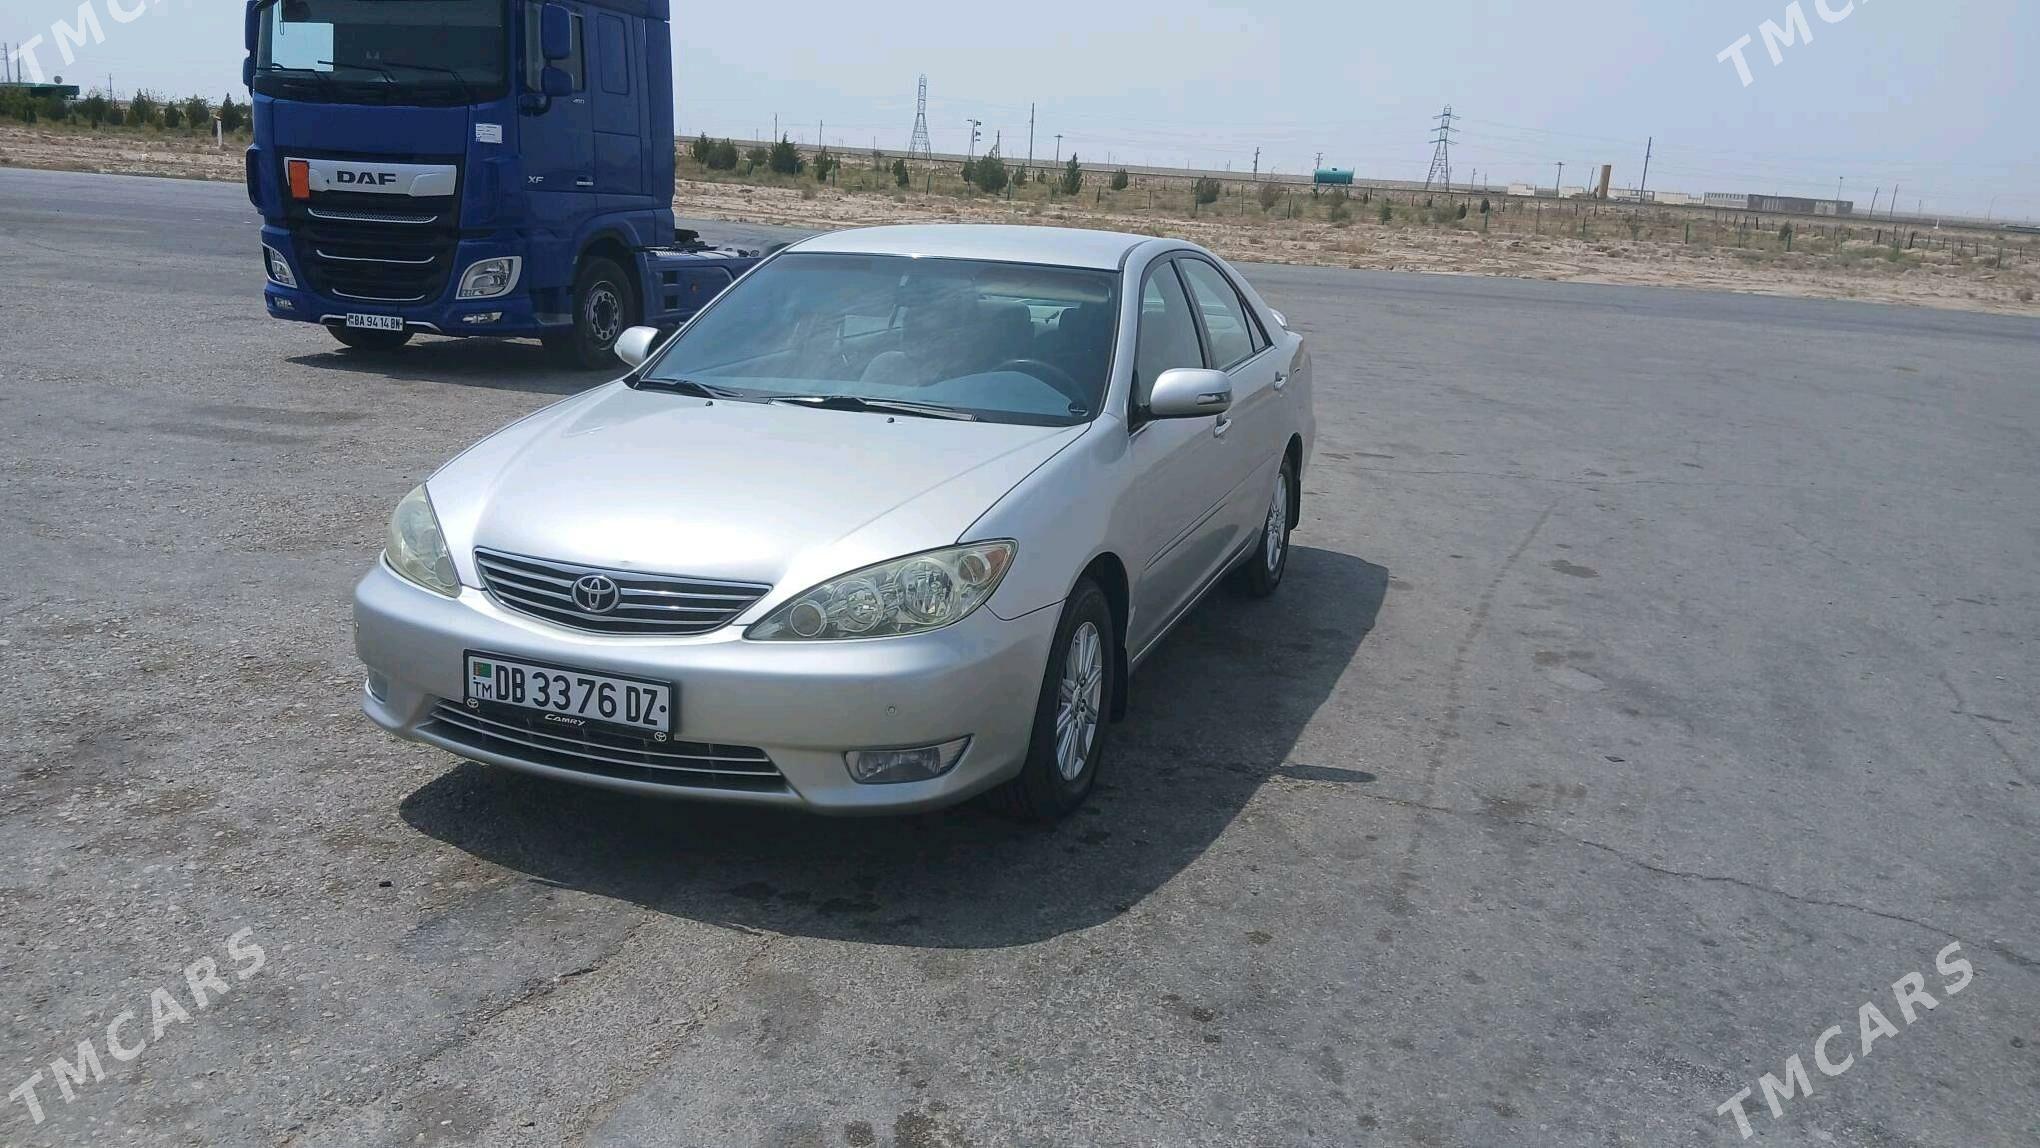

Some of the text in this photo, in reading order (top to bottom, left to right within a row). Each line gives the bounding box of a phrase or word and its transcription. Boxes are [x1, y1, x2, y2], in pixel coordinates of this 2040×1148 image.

[336, 170, 397, 186] DAF
[528, 176, 544, 184] XF
[473, 681, 492, 699] TM
[495, 664, 526, 704] DB
[626, 685, 658, 726] DZ
[544, 713, 586, 727] CAMRY
